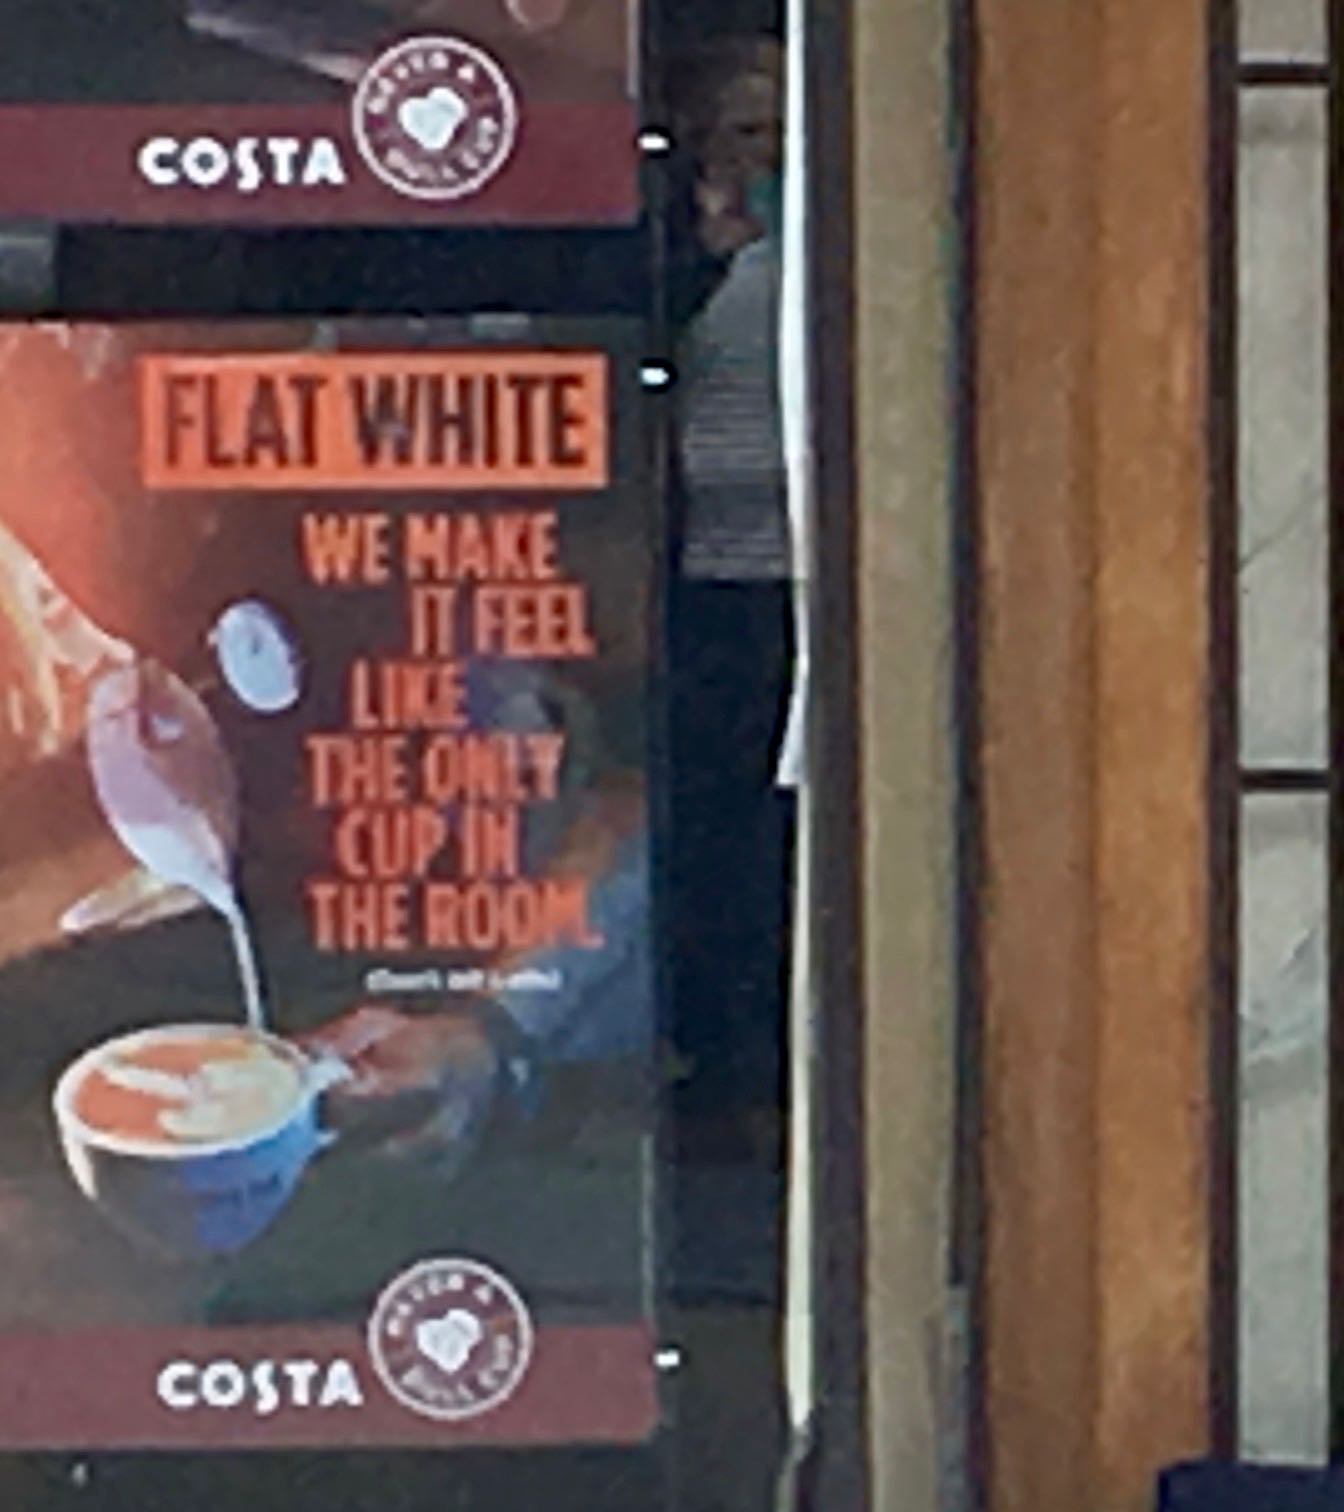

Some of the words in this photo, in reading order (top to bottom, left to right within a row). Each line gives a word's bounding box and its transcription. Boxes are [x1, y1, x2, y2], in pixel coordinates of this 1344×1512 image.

[138, 136, 346, 190] COSTA
[163, 373, 328, 468] FLAT
[350, 373, 588, 469] WHITE
[302, 511, 391, 586] WE
[404, 510, 558, 581] MAKE
[411, 583, 456, 656] IT
[474, 583, 598, 658] FEEL
[352, 658, 469, 729] LIKE
[305, 735, 409, 806] THE
[423, 734, 565, 803] ONLY
[335, 806, 447, 876] CUP
[463, 802, 519, 876] IN
[306, 881, 410, 951] THE
[425, 876, 605, 951] ROOM.
[155, 1358, 364, 1414] COSTA
